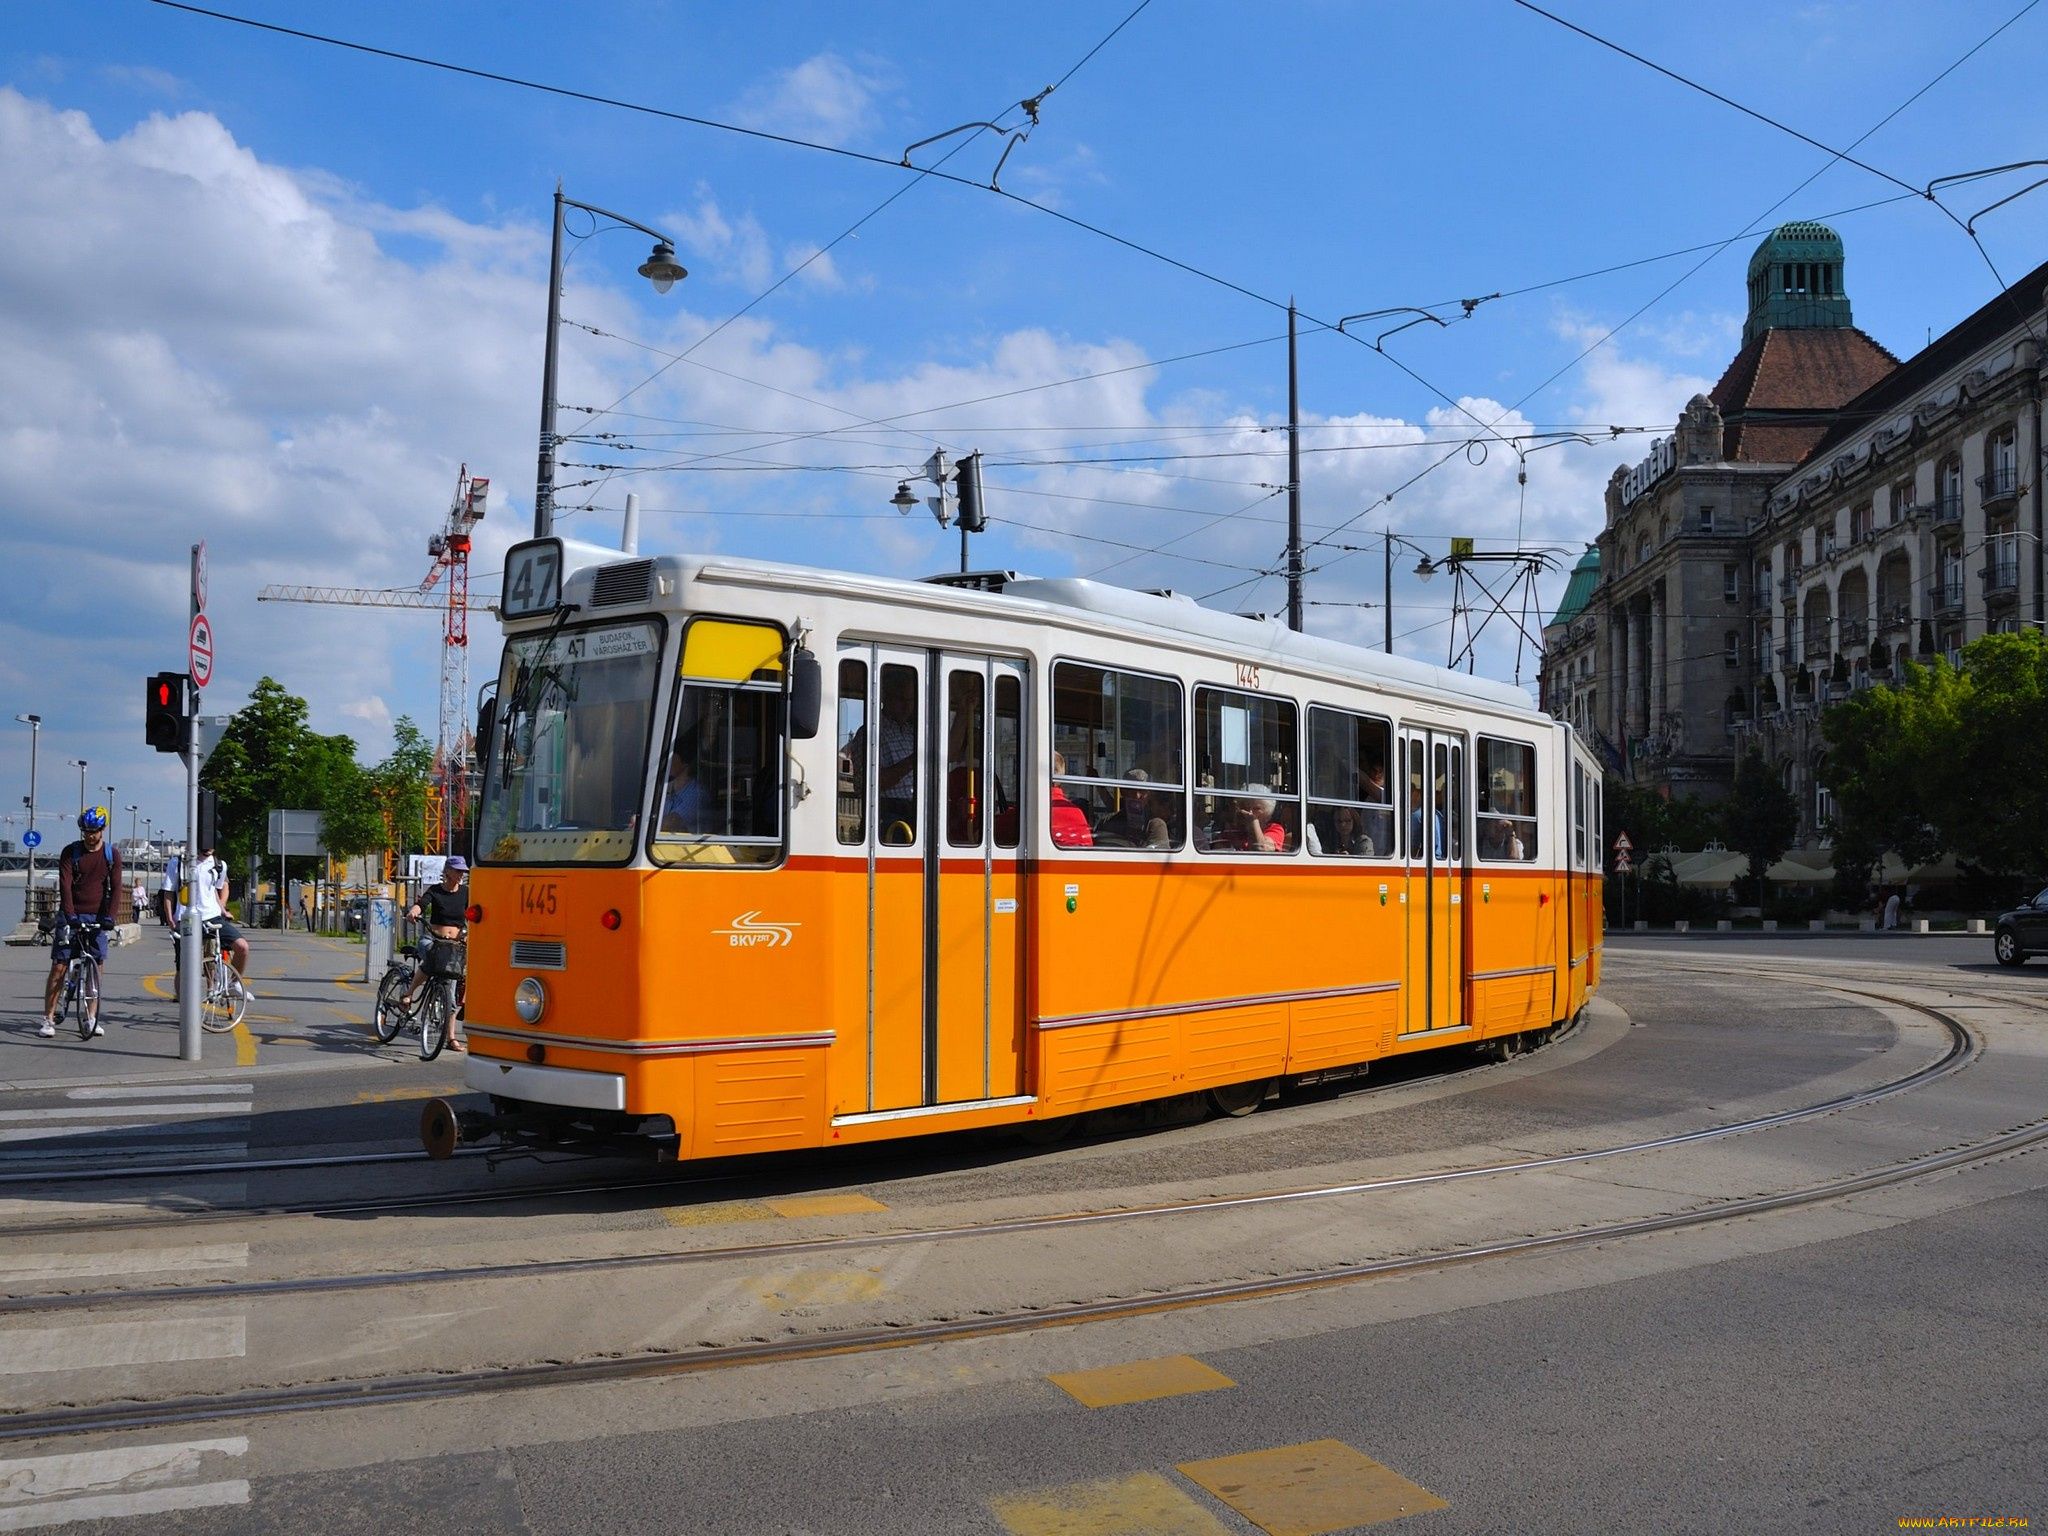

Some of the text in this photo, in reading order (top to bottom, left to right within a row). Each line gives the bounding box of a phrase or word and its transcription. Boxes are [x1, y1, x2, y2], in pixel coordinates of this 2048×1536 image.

[511, 553, 558, 610] 47
[568, 638, 586, 658] 47
[599, 631, 635, 644] BUDAFOK,
[1236, 662, 1260, 689] 1445
[520, 883, 557, 915] 1445
[729, 934, 757, 947] BKV
